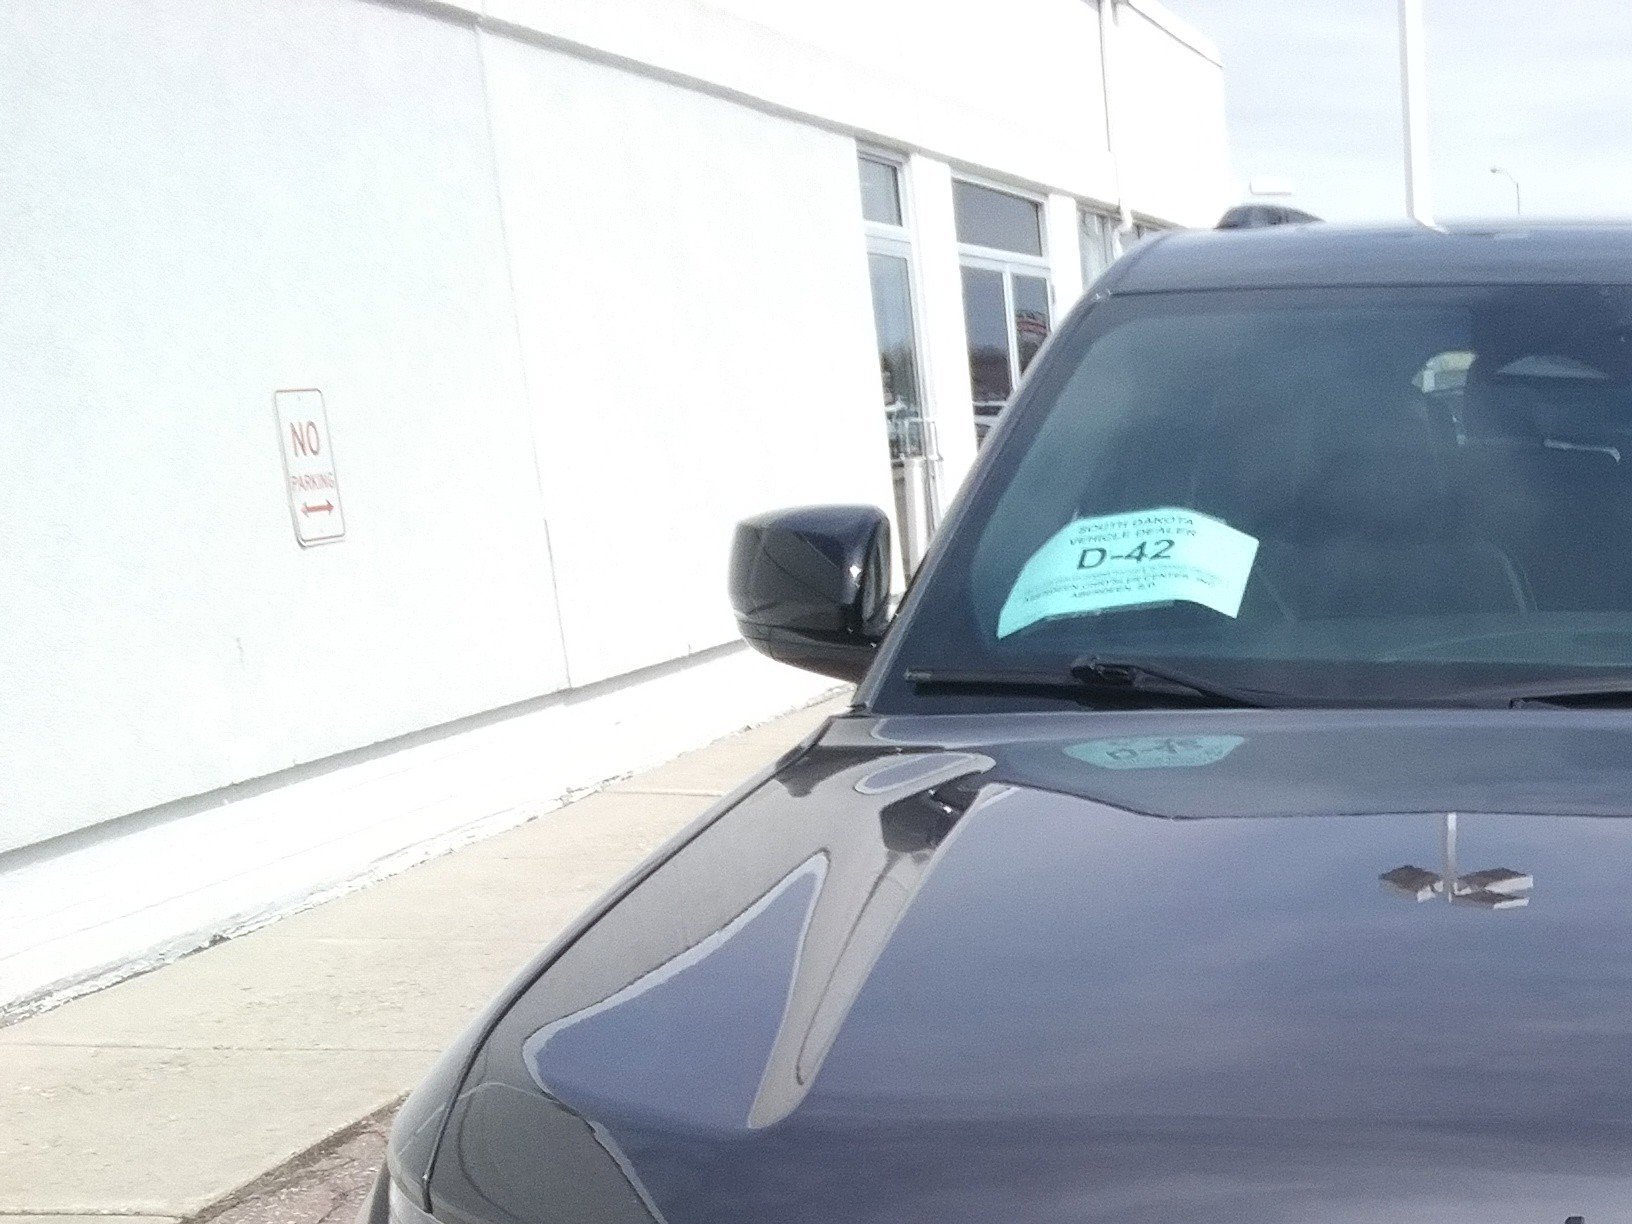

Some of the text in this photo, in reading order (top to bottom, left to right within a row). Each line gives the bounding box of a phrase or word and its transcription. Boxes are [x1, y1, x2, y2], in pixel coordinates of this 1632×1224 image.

[290, 420, 320, 458] NO
[1078, 516, 1194, 534] SOUTH DAKOTA
[1136, 526, 1197, 538] DEALER
[1077, 539, 1175, 570] D-42
